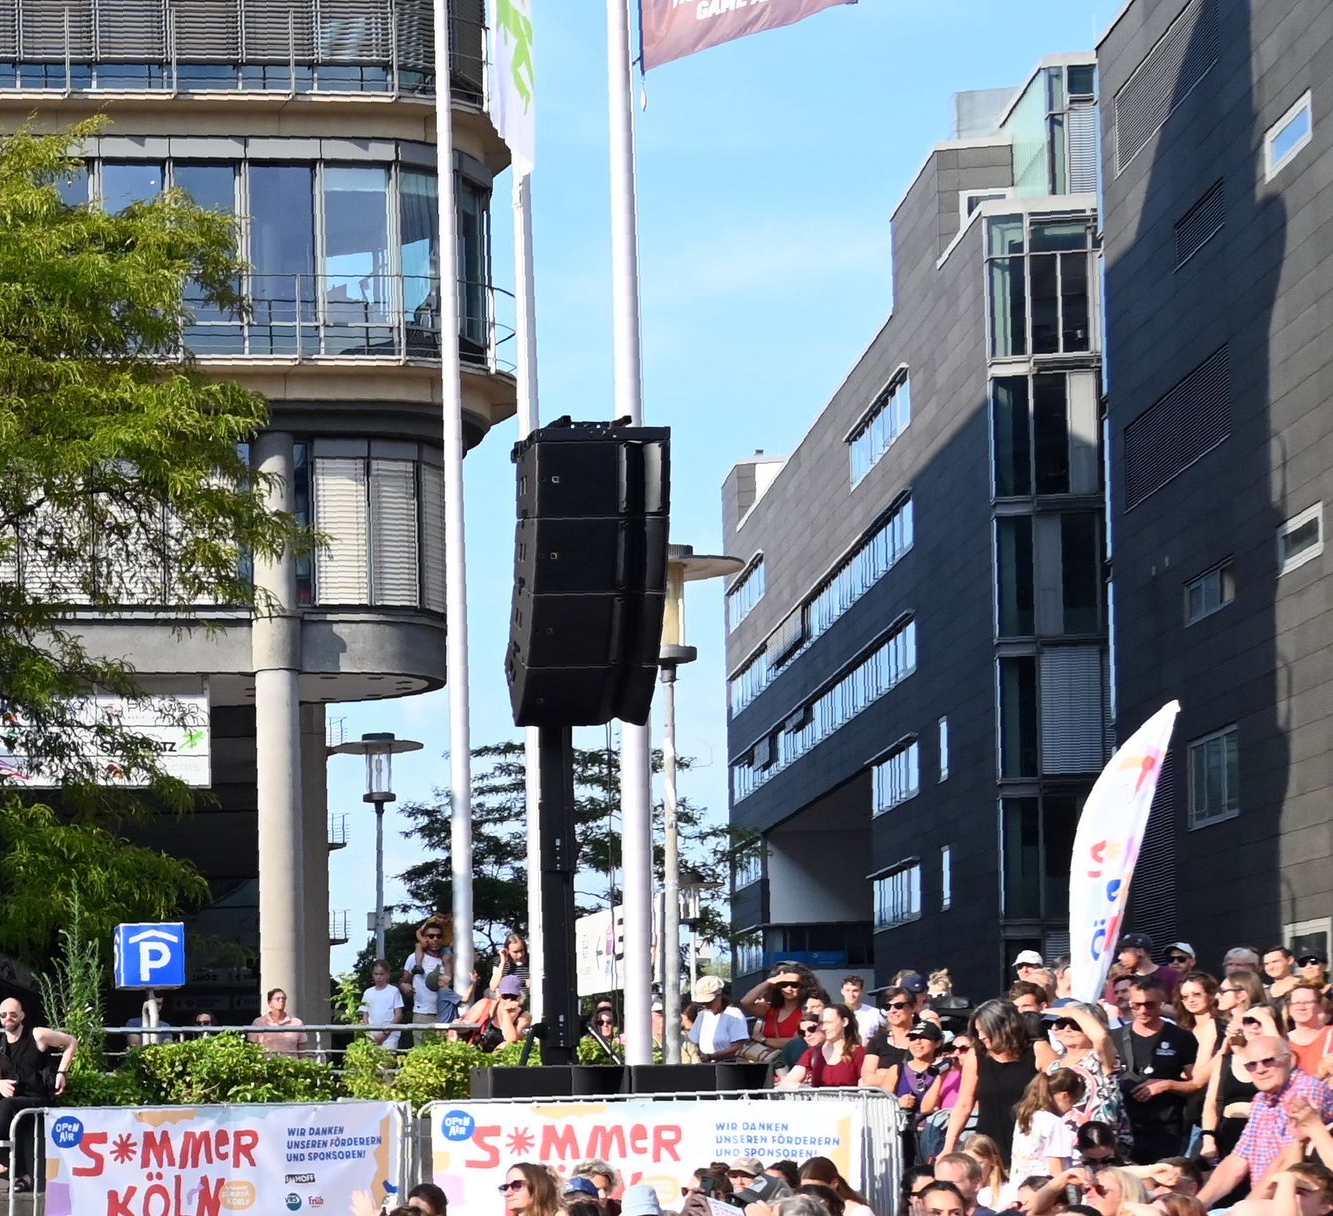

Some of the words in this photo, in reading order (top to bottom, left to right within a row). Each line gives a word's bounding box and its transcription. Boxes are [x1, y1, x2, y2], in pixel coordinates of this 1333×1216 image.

[140, 942, 172, 982] P
[287, 1127, 306, 1137] WIR
[308, 1126, 344, 1136] DANKEN
[716, 1122, 738, 1131] WIR
[742, 1122, 788, 1132] DANKEN
[286, 1139, 328, 1149] UNSEREN
[330, 1136, 382, 1148] FÖRDERERN
[716, 1135, 768, 1144] UNSEREN
[772, 1133, 840, 1146] FÖRDERERN
[286, 1152, 306, 1162] UND
[308, 1150, 365, 1161] SPONSOREN!
[716, 1148, 740, 1157] UND
